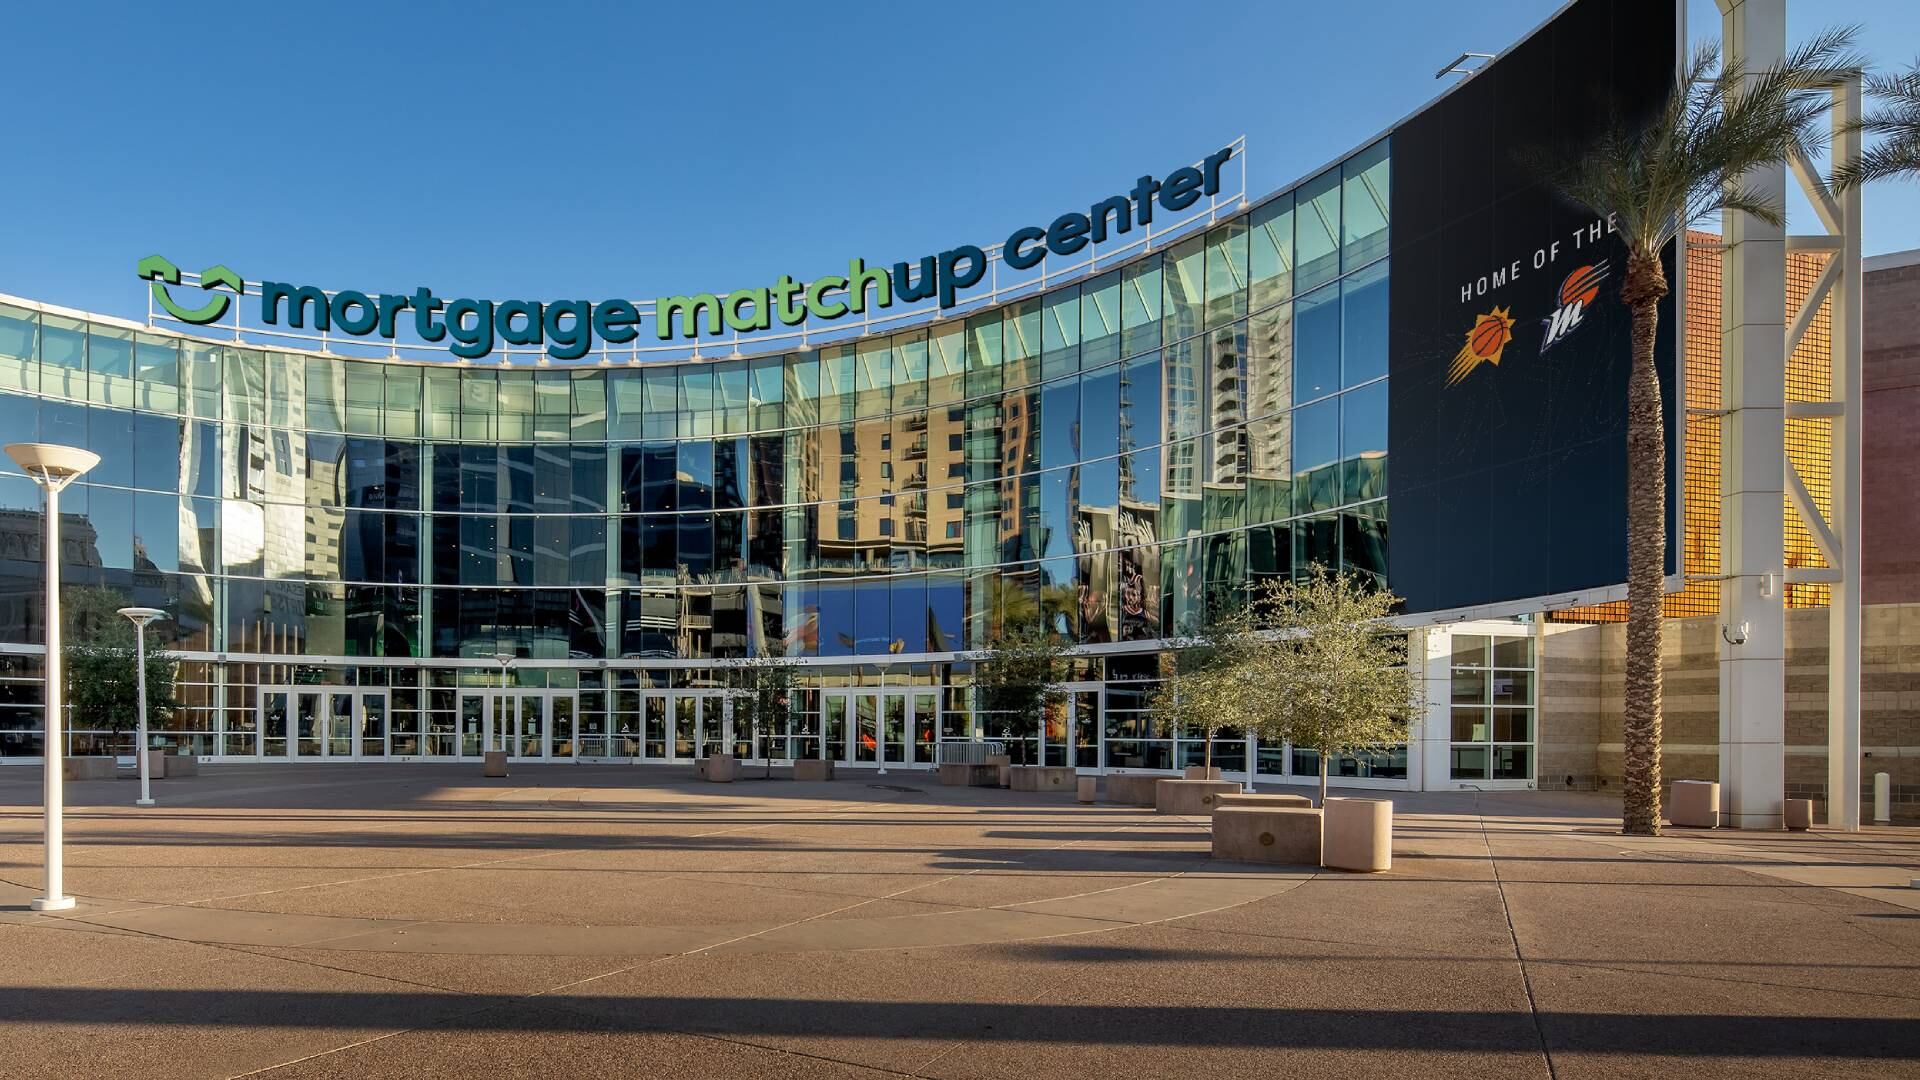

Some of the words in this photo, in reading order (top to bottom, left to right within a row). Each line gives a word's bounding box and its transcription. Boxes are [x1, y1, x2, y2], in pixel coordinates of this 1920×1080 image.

[262, 280, 640, 360] mortgage
[656, 243, 986, 340] matchup
[1003, 146, 1232, 270] center
[1461, 260, 1521, 303] HOME
[1533, 240, 1560, 269] OF
[1573, 211, 1617, 249] THE
